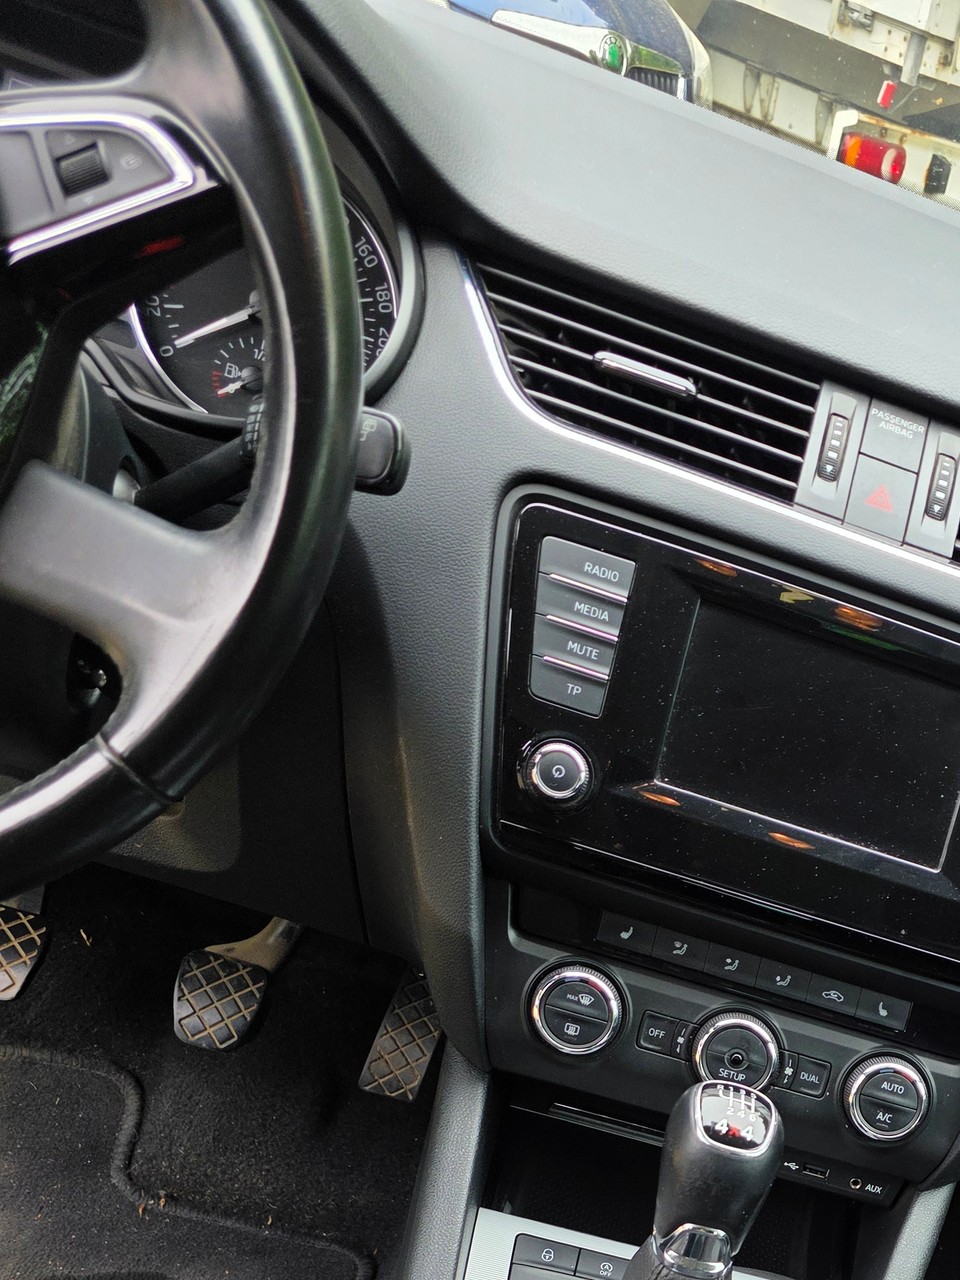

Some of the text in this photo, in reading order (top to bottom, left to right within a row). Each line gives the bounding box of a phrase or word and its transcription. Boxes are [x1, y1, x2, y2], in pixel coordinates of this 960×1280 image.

[354, 236, 379, 268] 160
[375, 282, 393, 313] 180
[160, 345, 174, 357] 0
[871, 407, 925, 434] PASSENGER
[879, 420, 914, 439] AIRBAG
[584, 562, 620, 582] RADIO
[574, 601, 609, 622] MEDIA
[567, 640, 600, 660] MUTE
[566, 683, 582, 695] TP
[648, 1027, 666, 1039] OFF
[718, 1068, 746, 1082] SETUP
[800, 1071, 820, 1084] DUAL
[881, 1081, 905, 1095] AUTO
[726, 1107, 757, 1122] 2 4 6
[876, 1111, 893, 1123] A/C
[865, 1183, 883, 1194] AUX
